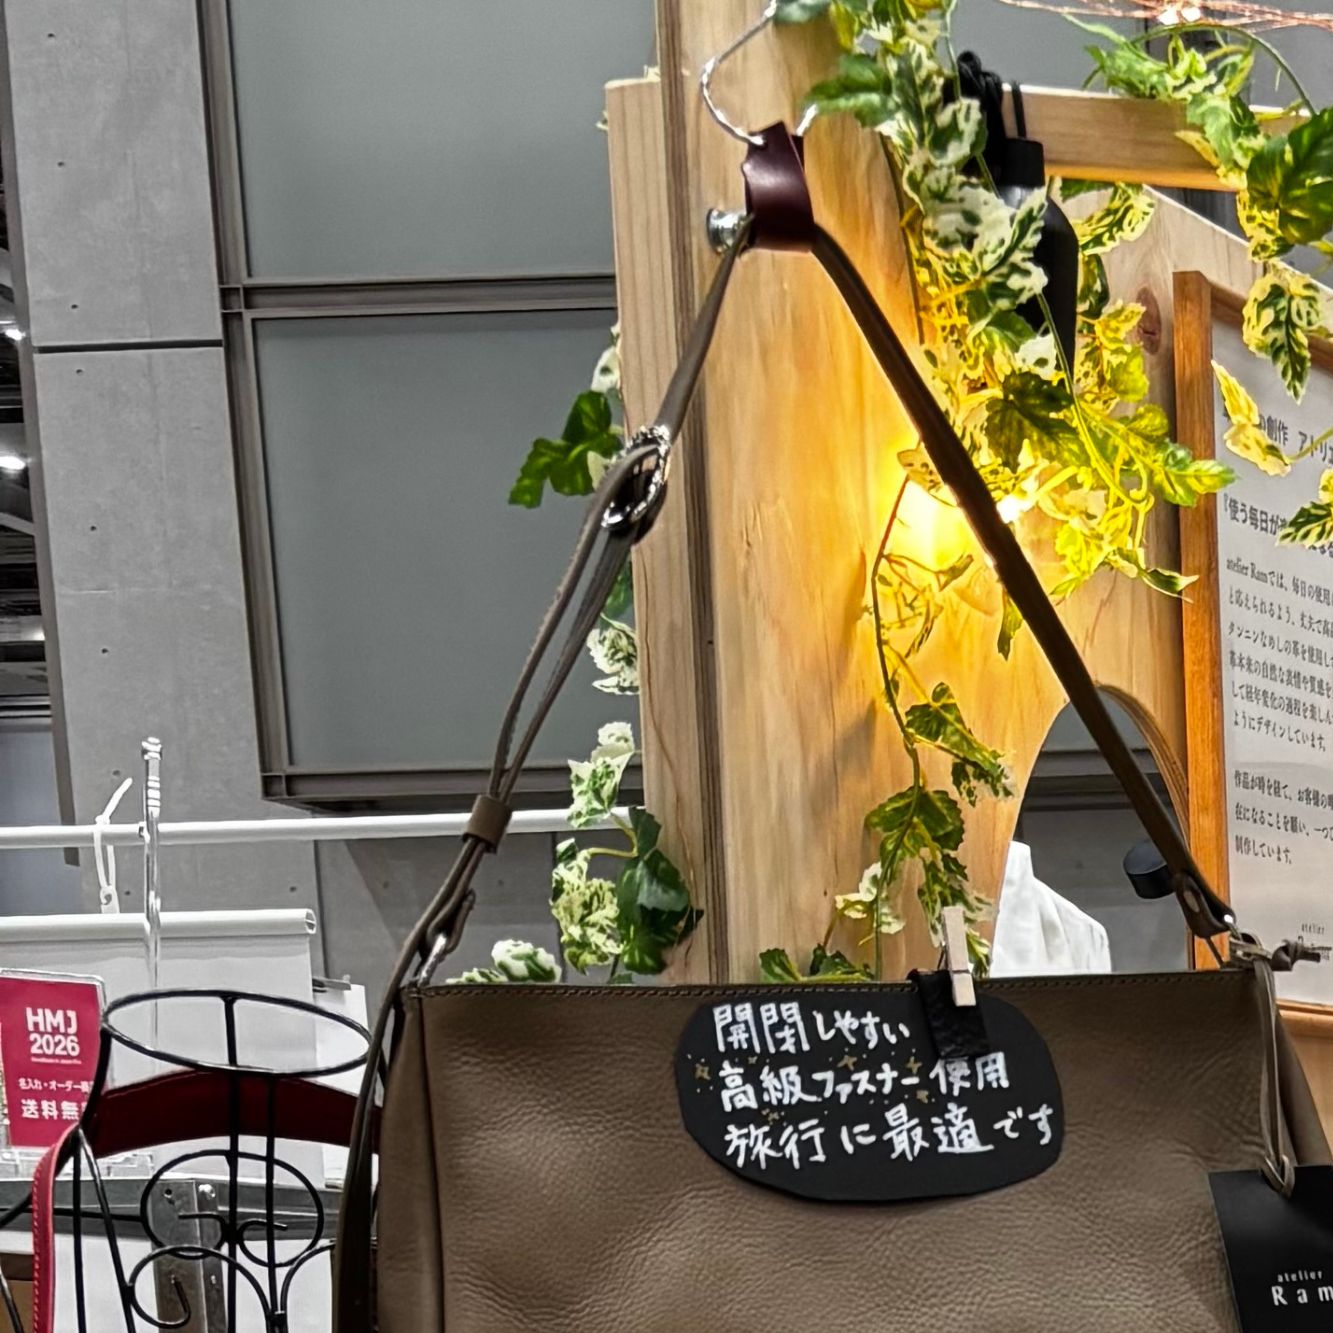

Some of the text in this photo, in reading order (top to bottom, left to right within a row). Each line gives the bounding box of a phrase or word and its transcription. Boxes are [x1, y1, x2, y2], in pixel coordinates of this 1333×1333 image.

[26, 1007, 78, 1034] HMJ
[712, 1003, 911, 1056] 開閉しやすい
[29, 1033, 80, 1057] 2026
[718, 1052, 1010, 1112] 高級ファスナー使用
[21, 1099, 87, 1120] 送料無
[723, 1103, 1056, 1171] 旅行に最適です
[1277, 1270, 1323, 1283] atelier
